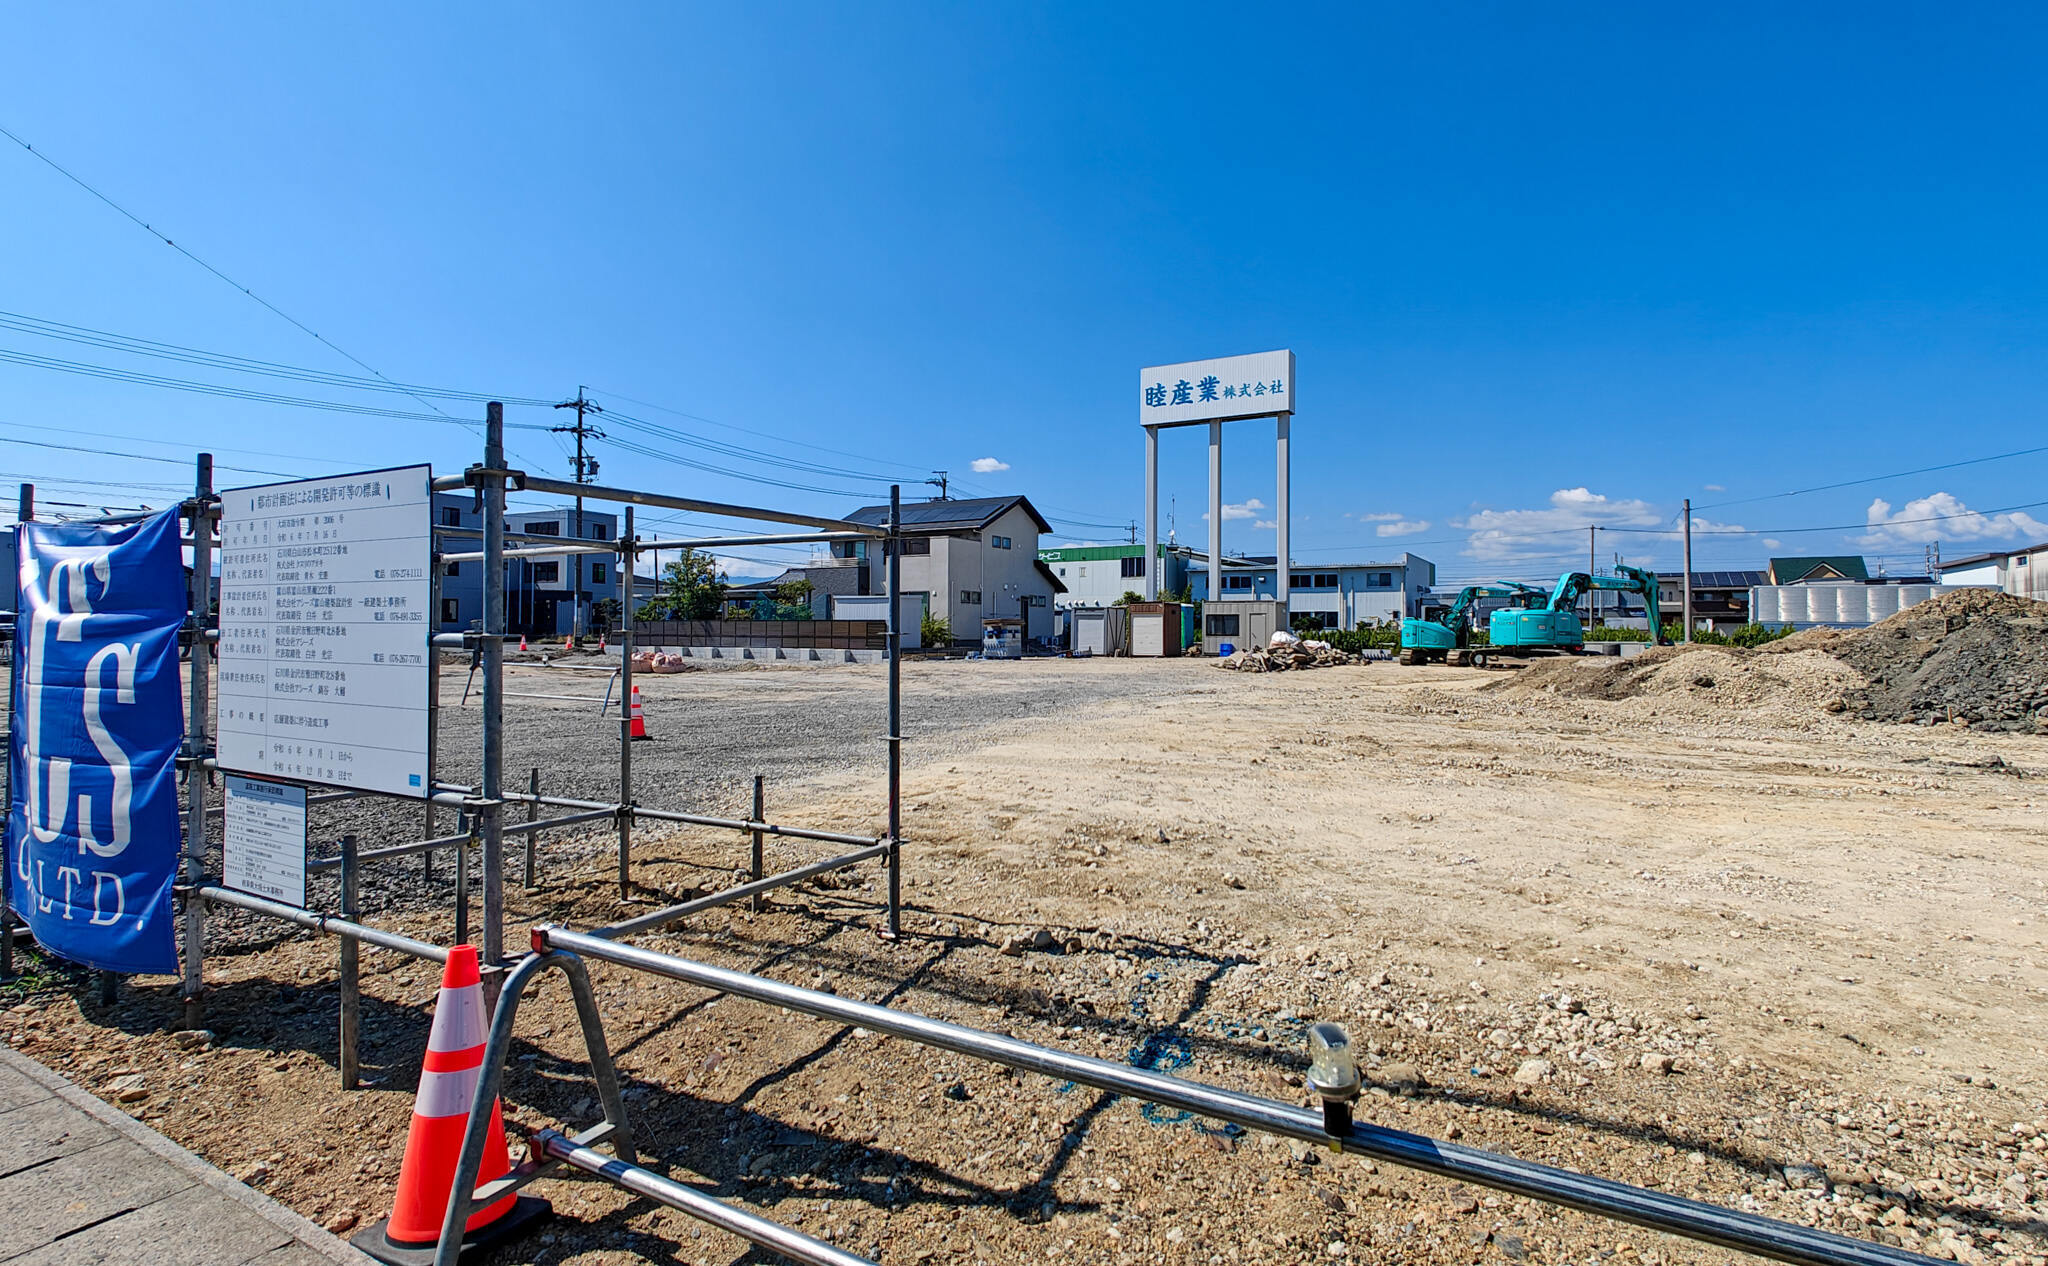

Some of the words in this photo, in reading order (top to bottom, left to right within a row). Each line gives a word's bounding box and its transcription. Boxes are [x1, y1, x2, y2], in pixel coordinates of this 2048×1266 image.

[256, 481, 382, 510] 都市計画法による開発許可等の標識
